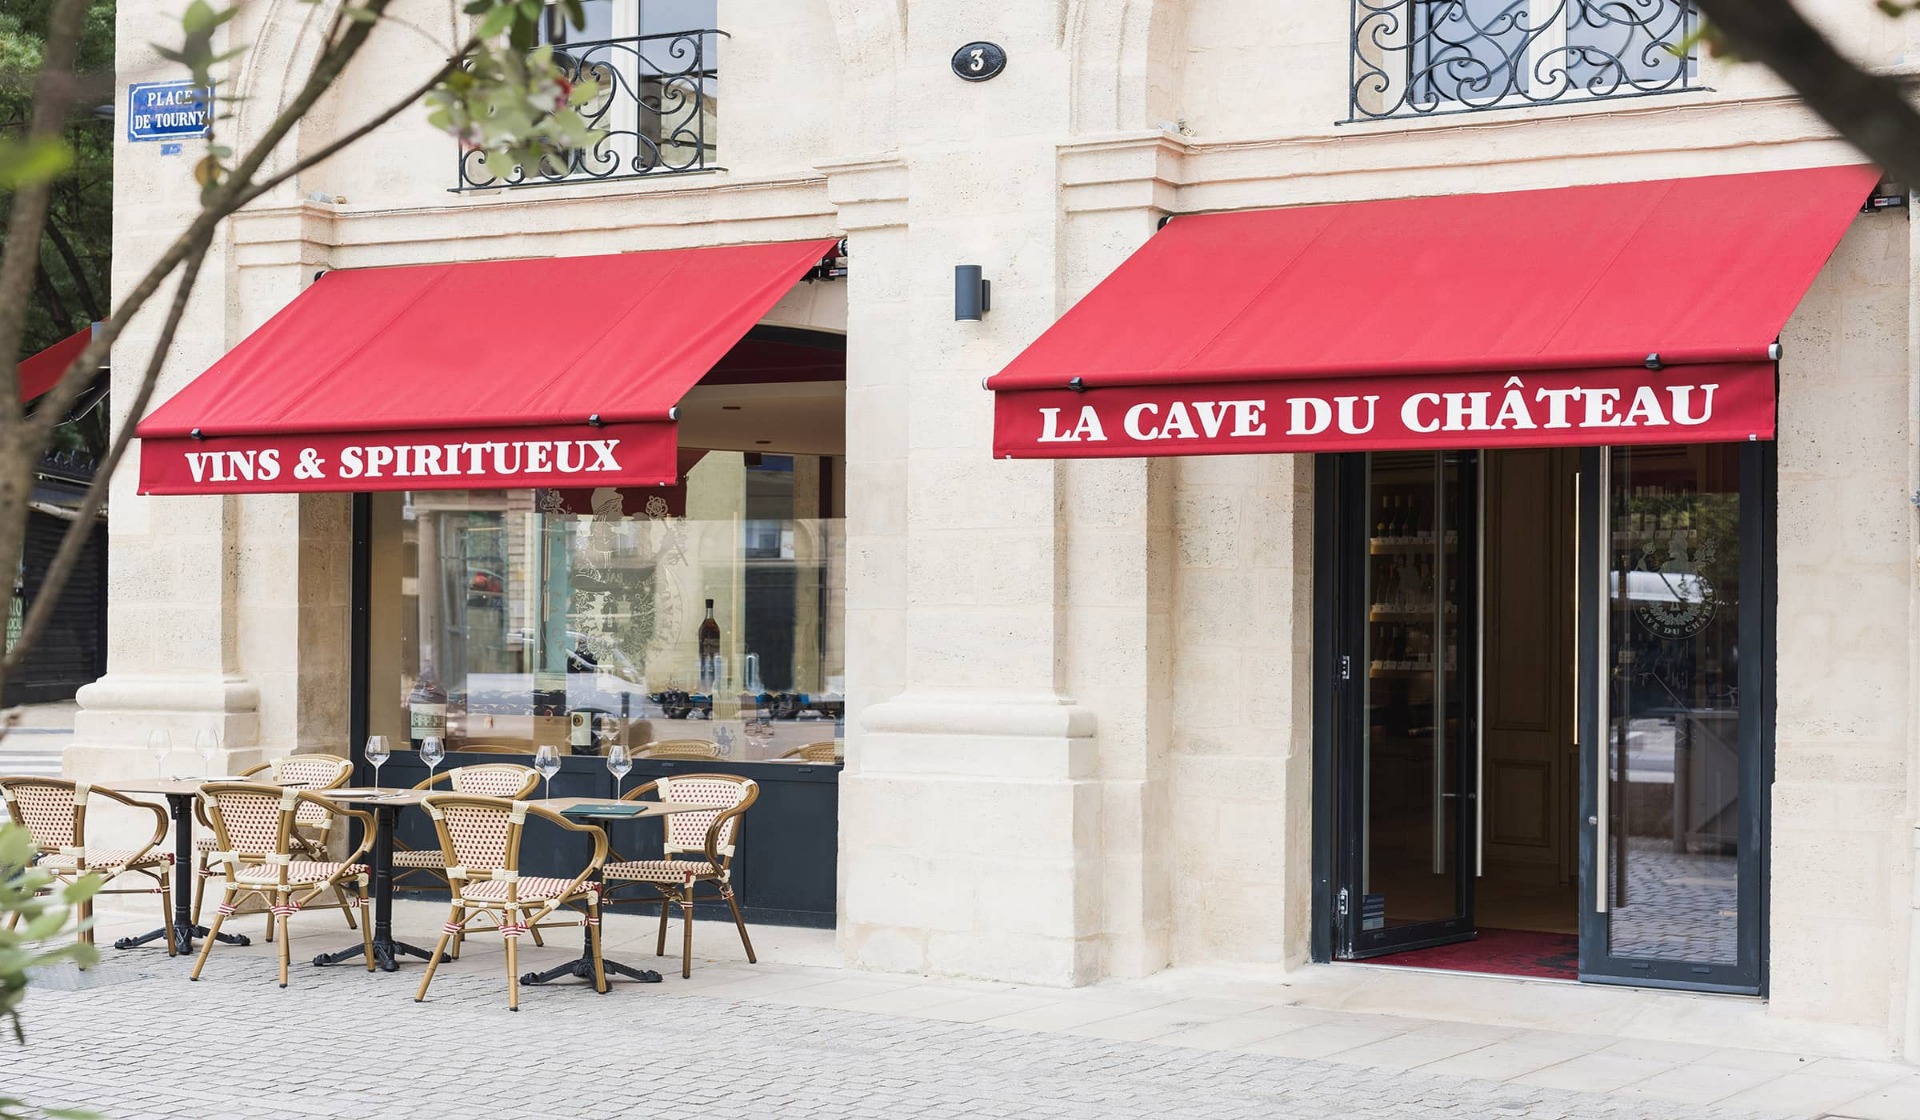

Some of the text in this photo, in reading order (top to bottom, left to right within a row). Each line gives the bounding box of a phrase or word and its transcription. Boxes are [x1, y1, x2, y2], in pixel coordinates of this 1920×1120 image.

[970, 48, 984, 71] 3
[147, 89, 193, 107] PLACE
[135, 110, 206, 130] DE TOURNY
[1037, 376, 1719, 443] LA CAVE DU CHÂTEAU
[184, 439, 623, 483] VINS & SPIRITUEUX
[1640, 606, 1659, 630] CAVE
[1663, 627, 1680, 635] DU
